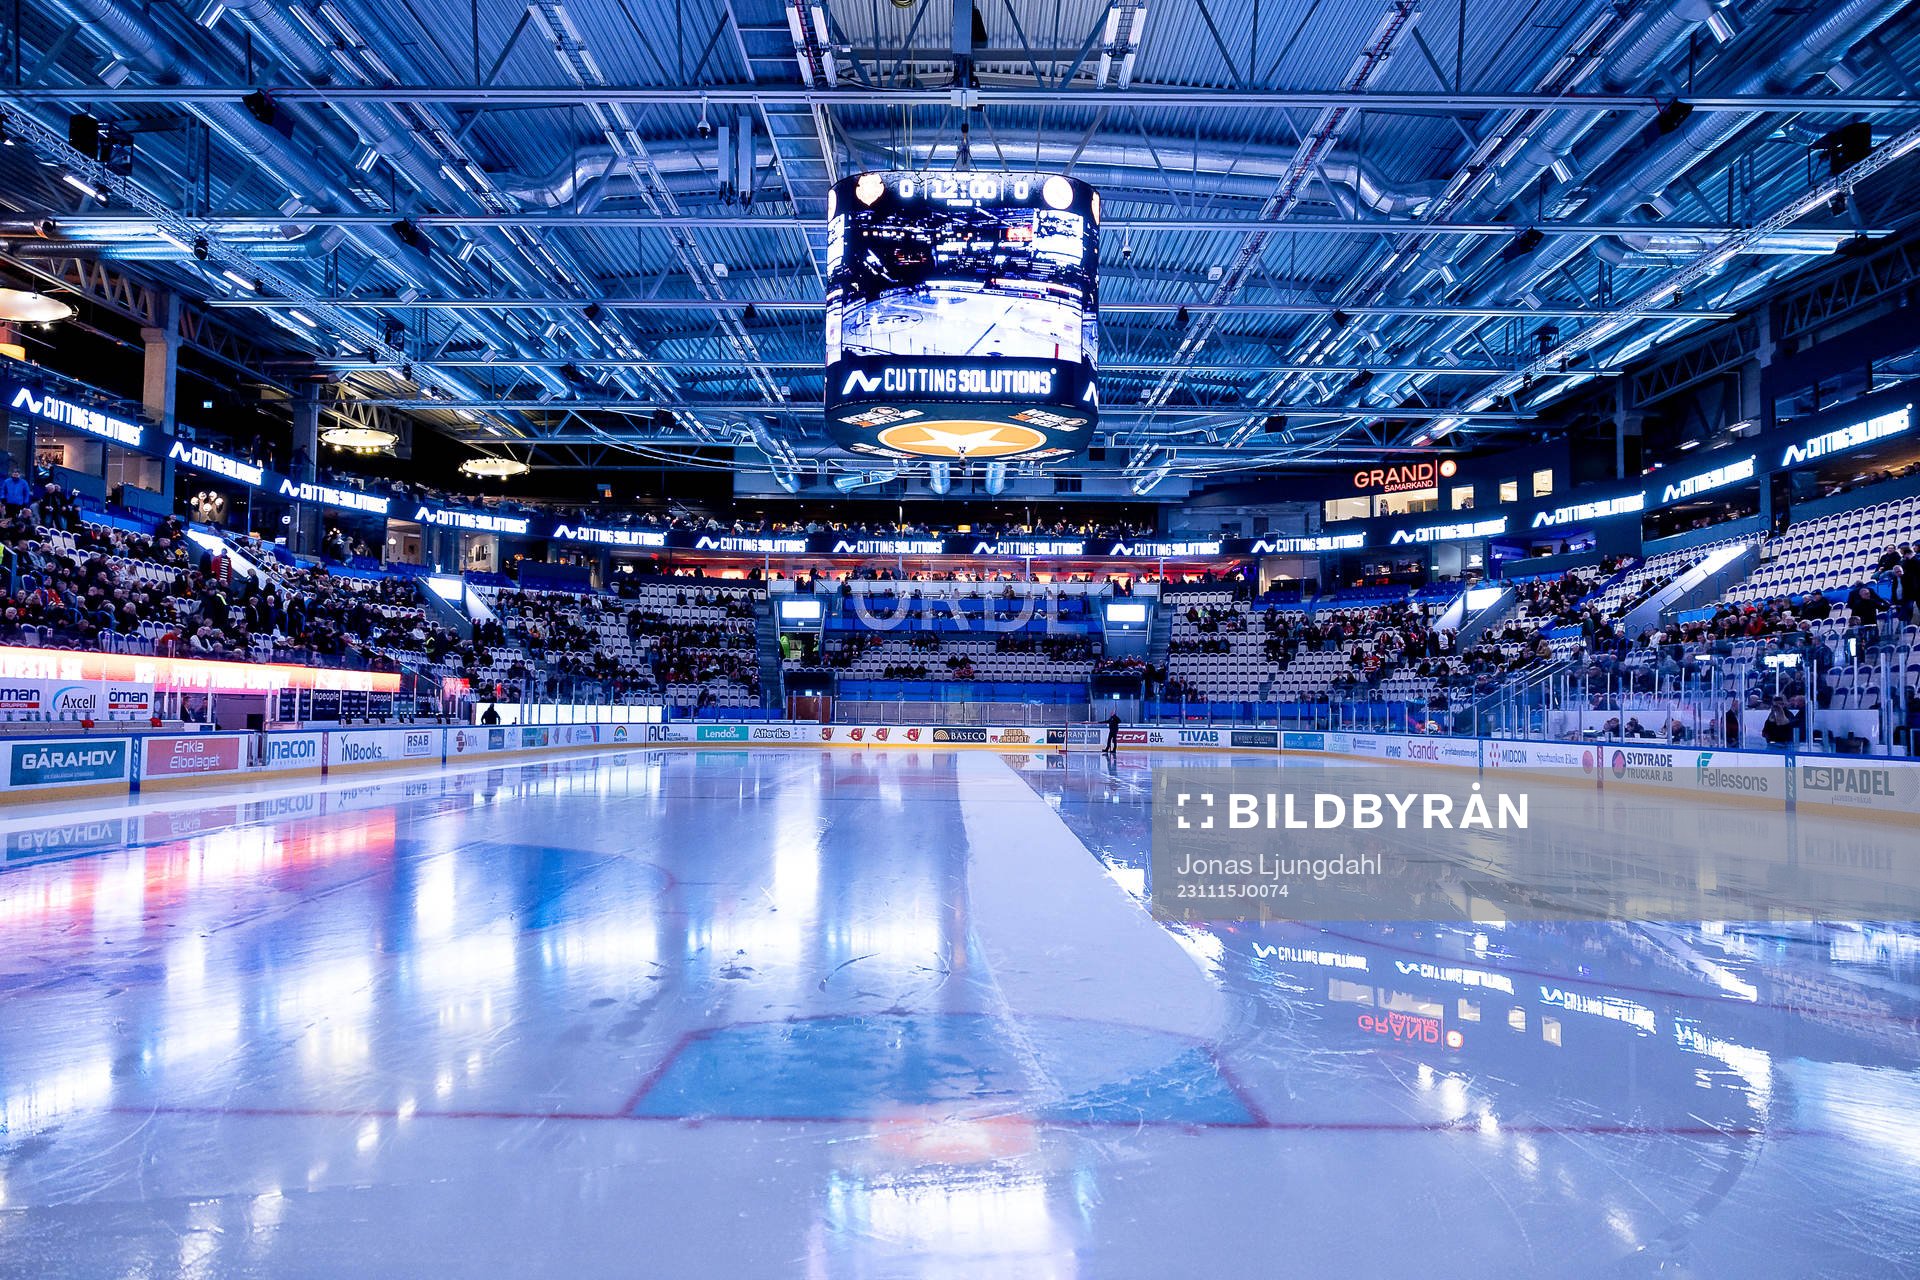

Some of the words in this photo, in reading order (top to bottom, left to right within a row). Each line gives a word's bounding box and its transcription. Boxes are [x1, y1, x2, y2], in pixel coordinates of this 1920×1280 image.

[900, 179, 914, 198] 0
[931, 179, 997, 199] 12:00
[1014, 181, 1029, 200] 0
[885, 368, 956, 392] CUTTING
[959, 369, 1052, 394] SOLUTIONS
[1354, 463, 1433, 488] GRAND
[1384, 480, 1433, 492] SAMARKAND
[0, 688, 40, 701] man
[109, 688, 149, 703] öman
[62, 695, 96, 709] Axcell
[705, 729, 732, 738] Lendo
[951, 732, 986, 740] BASECO
[1178, 731, 1219, 742] TIVAB
[174, 741, 204, 754] Enkla
[407, 735, 429, 747] RSAB
[1408, 740, 1439, 760] Scandic
[1502, 750, 1527, 763] MIDCON
[22, 748, 117, 770] GÄRAHOV
[170, 754, 221, 770] Elbolaget
[1626, 753, 1673, 768] SYDTRADE
[1627, 768, 1660, 781] TRUCKAR
[1662, 771, 1673, 782] AB
[1701, 767, 1768, 793] Fellessons
[1834, 768, 1895, 796] PADEL
